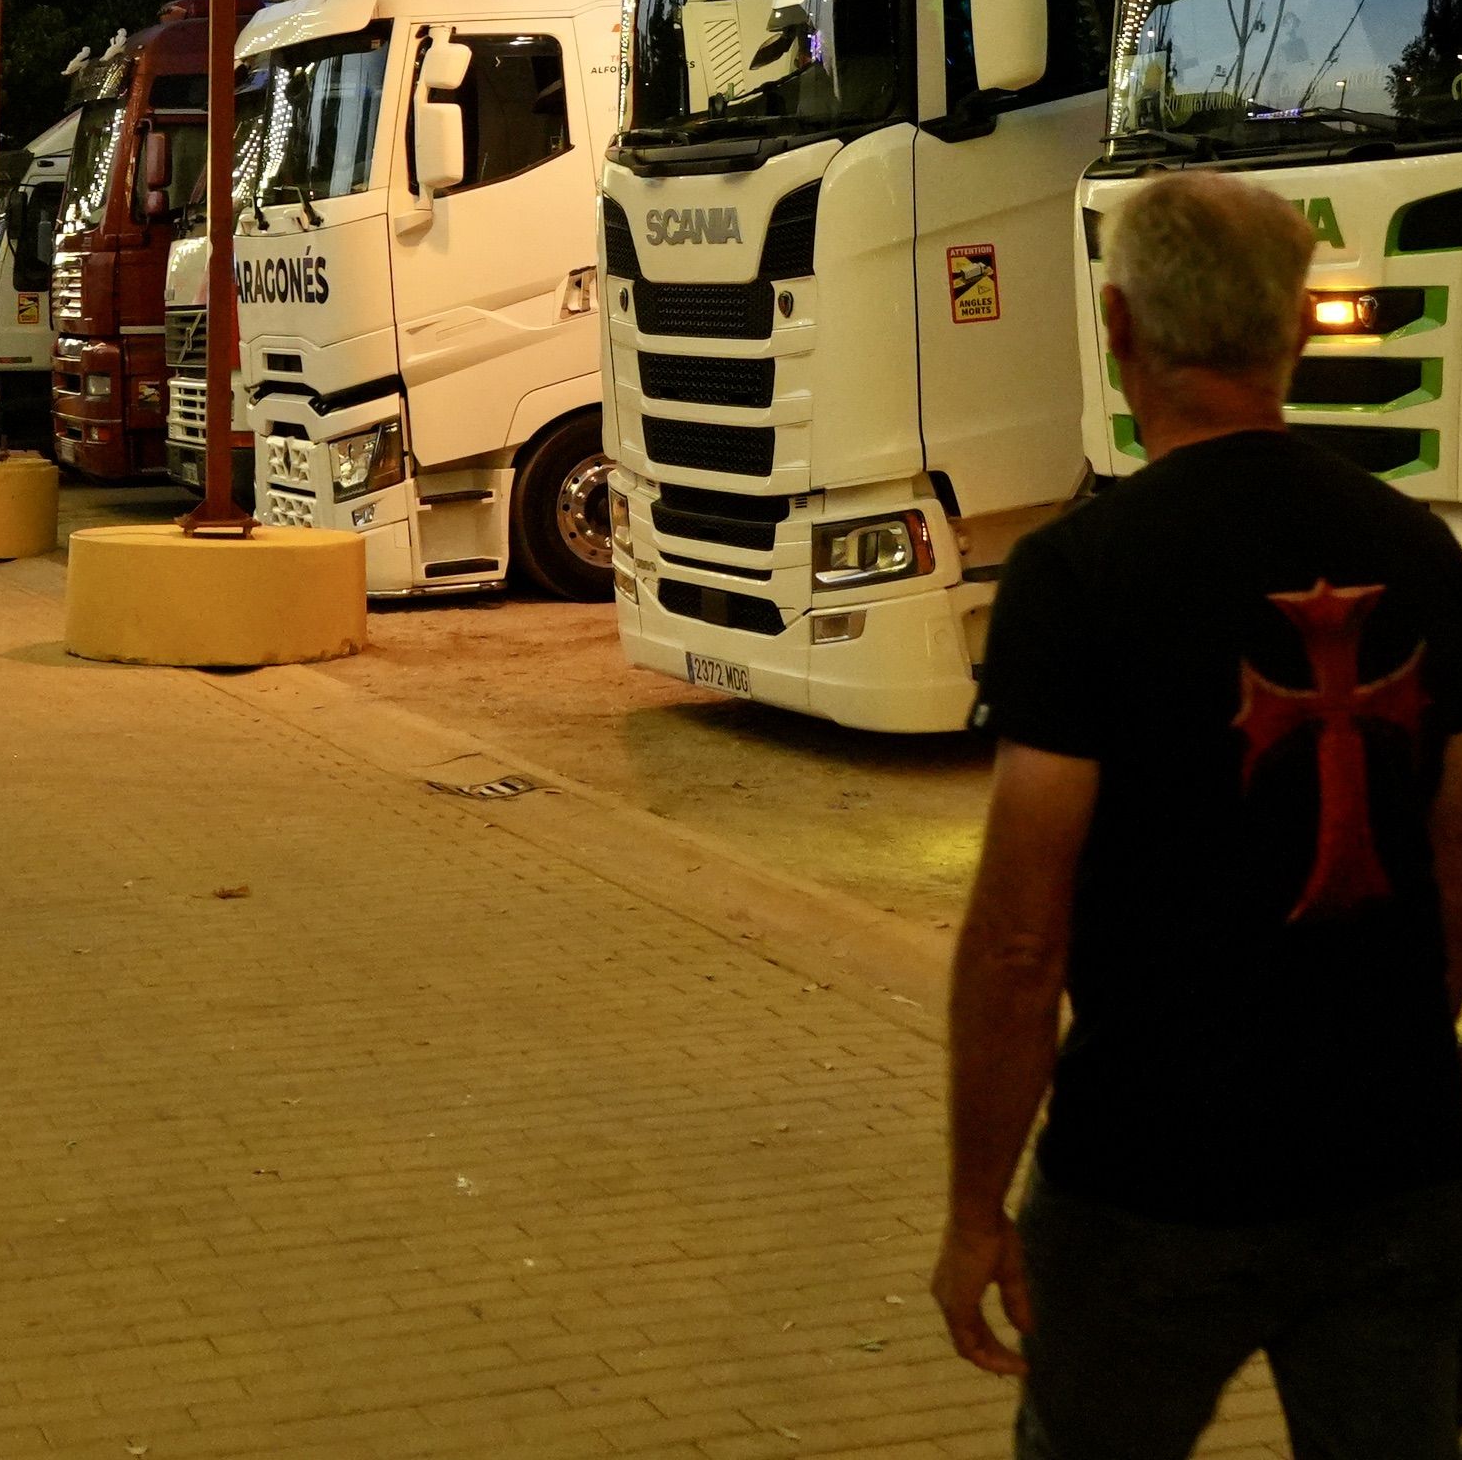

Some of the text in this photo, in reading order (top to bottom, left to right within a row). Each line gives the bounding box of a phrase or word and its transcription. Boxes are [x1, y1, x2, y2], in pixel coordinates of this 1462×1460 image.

[646, 208, 743, 246] SCANIA
[950, 246, 992, 256] ATTENTION
[236, 244, 329, 304] ARAGONÉS
[959, 297, 993, 308] ANGLES
[961, 306, 992, 316] MORTS
[694, 658, 723, 685] 2372
